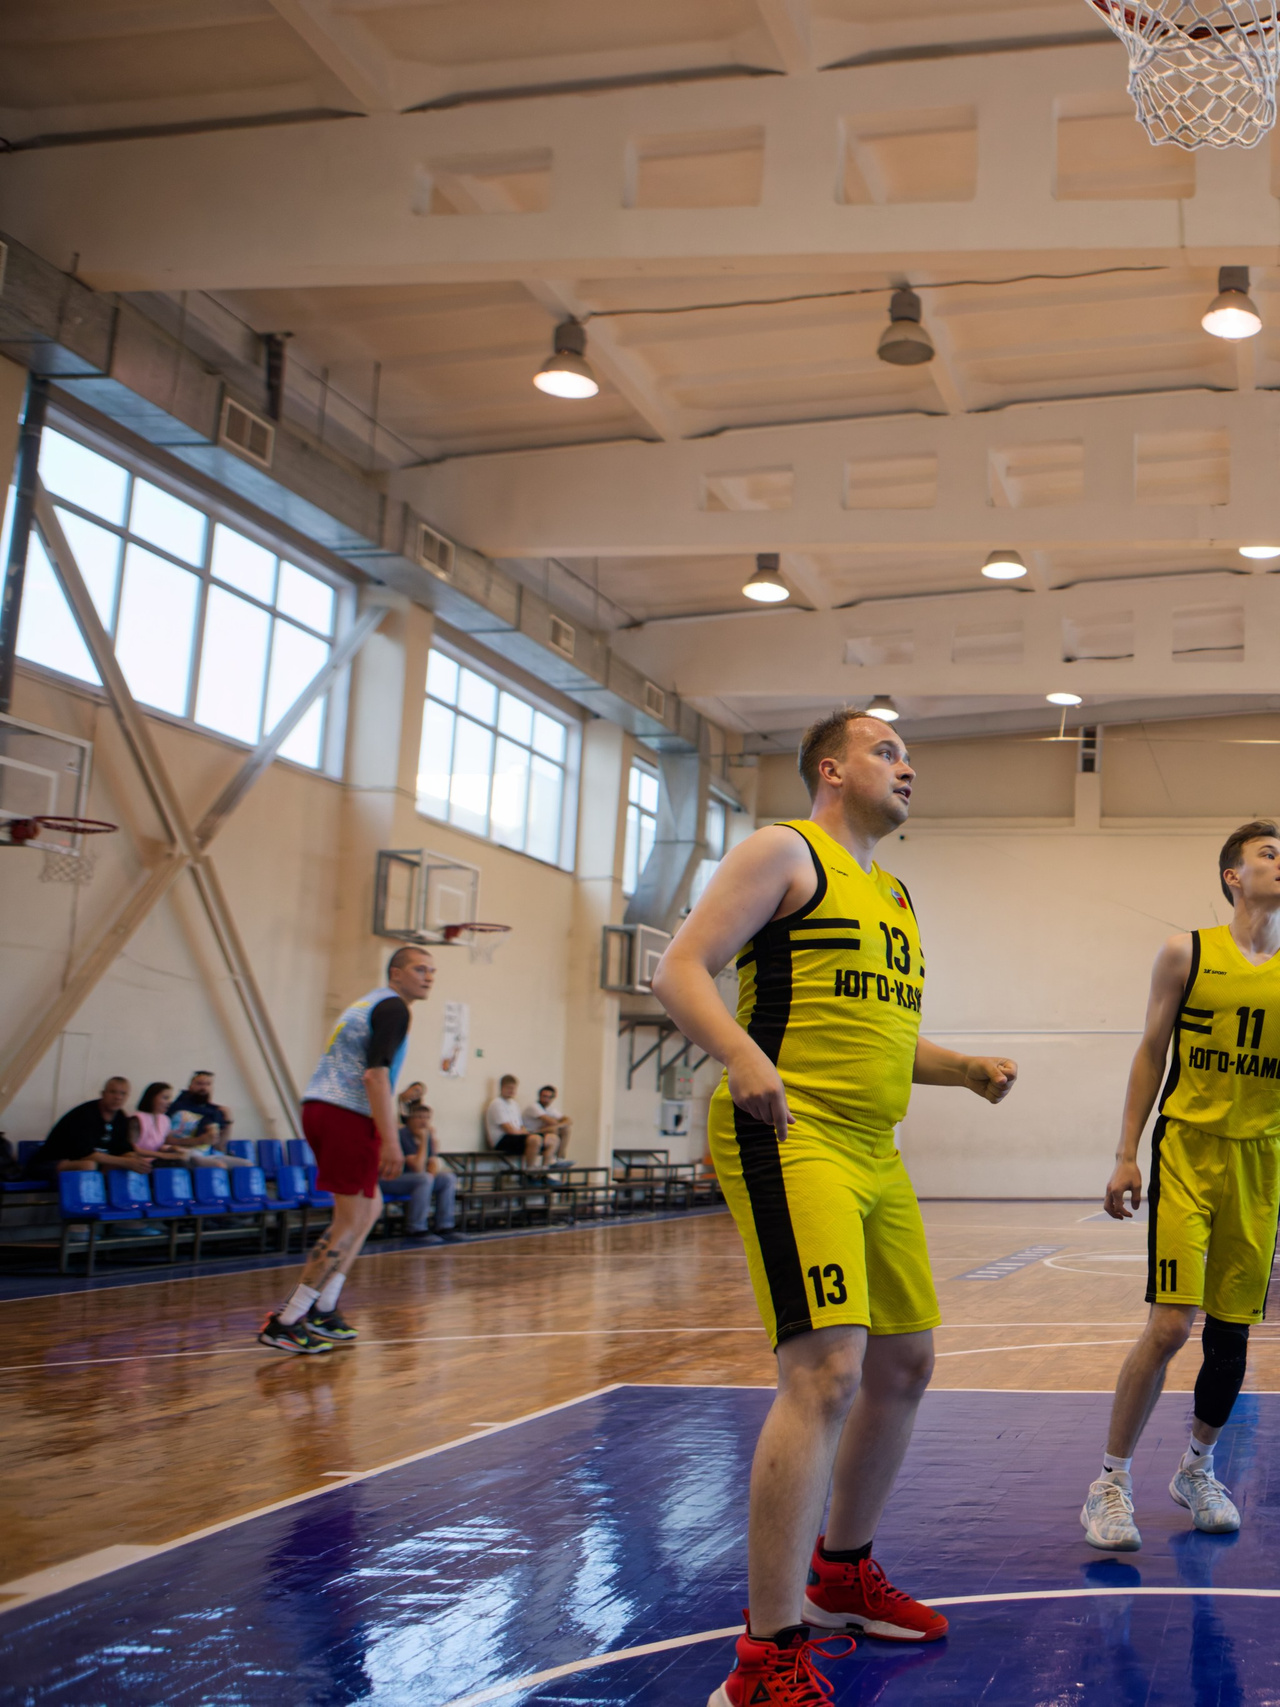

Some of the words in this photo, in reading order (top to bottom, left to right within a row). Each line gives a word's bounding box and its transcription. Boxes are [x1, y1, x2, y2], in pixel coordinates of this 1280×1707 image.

[879, 921, 911, 975] 13
[1236, 1006, 1266, 1049] 11
[807, 1263, 848, 1308] 13
[1159, 1259, 1177, 1292] 11
